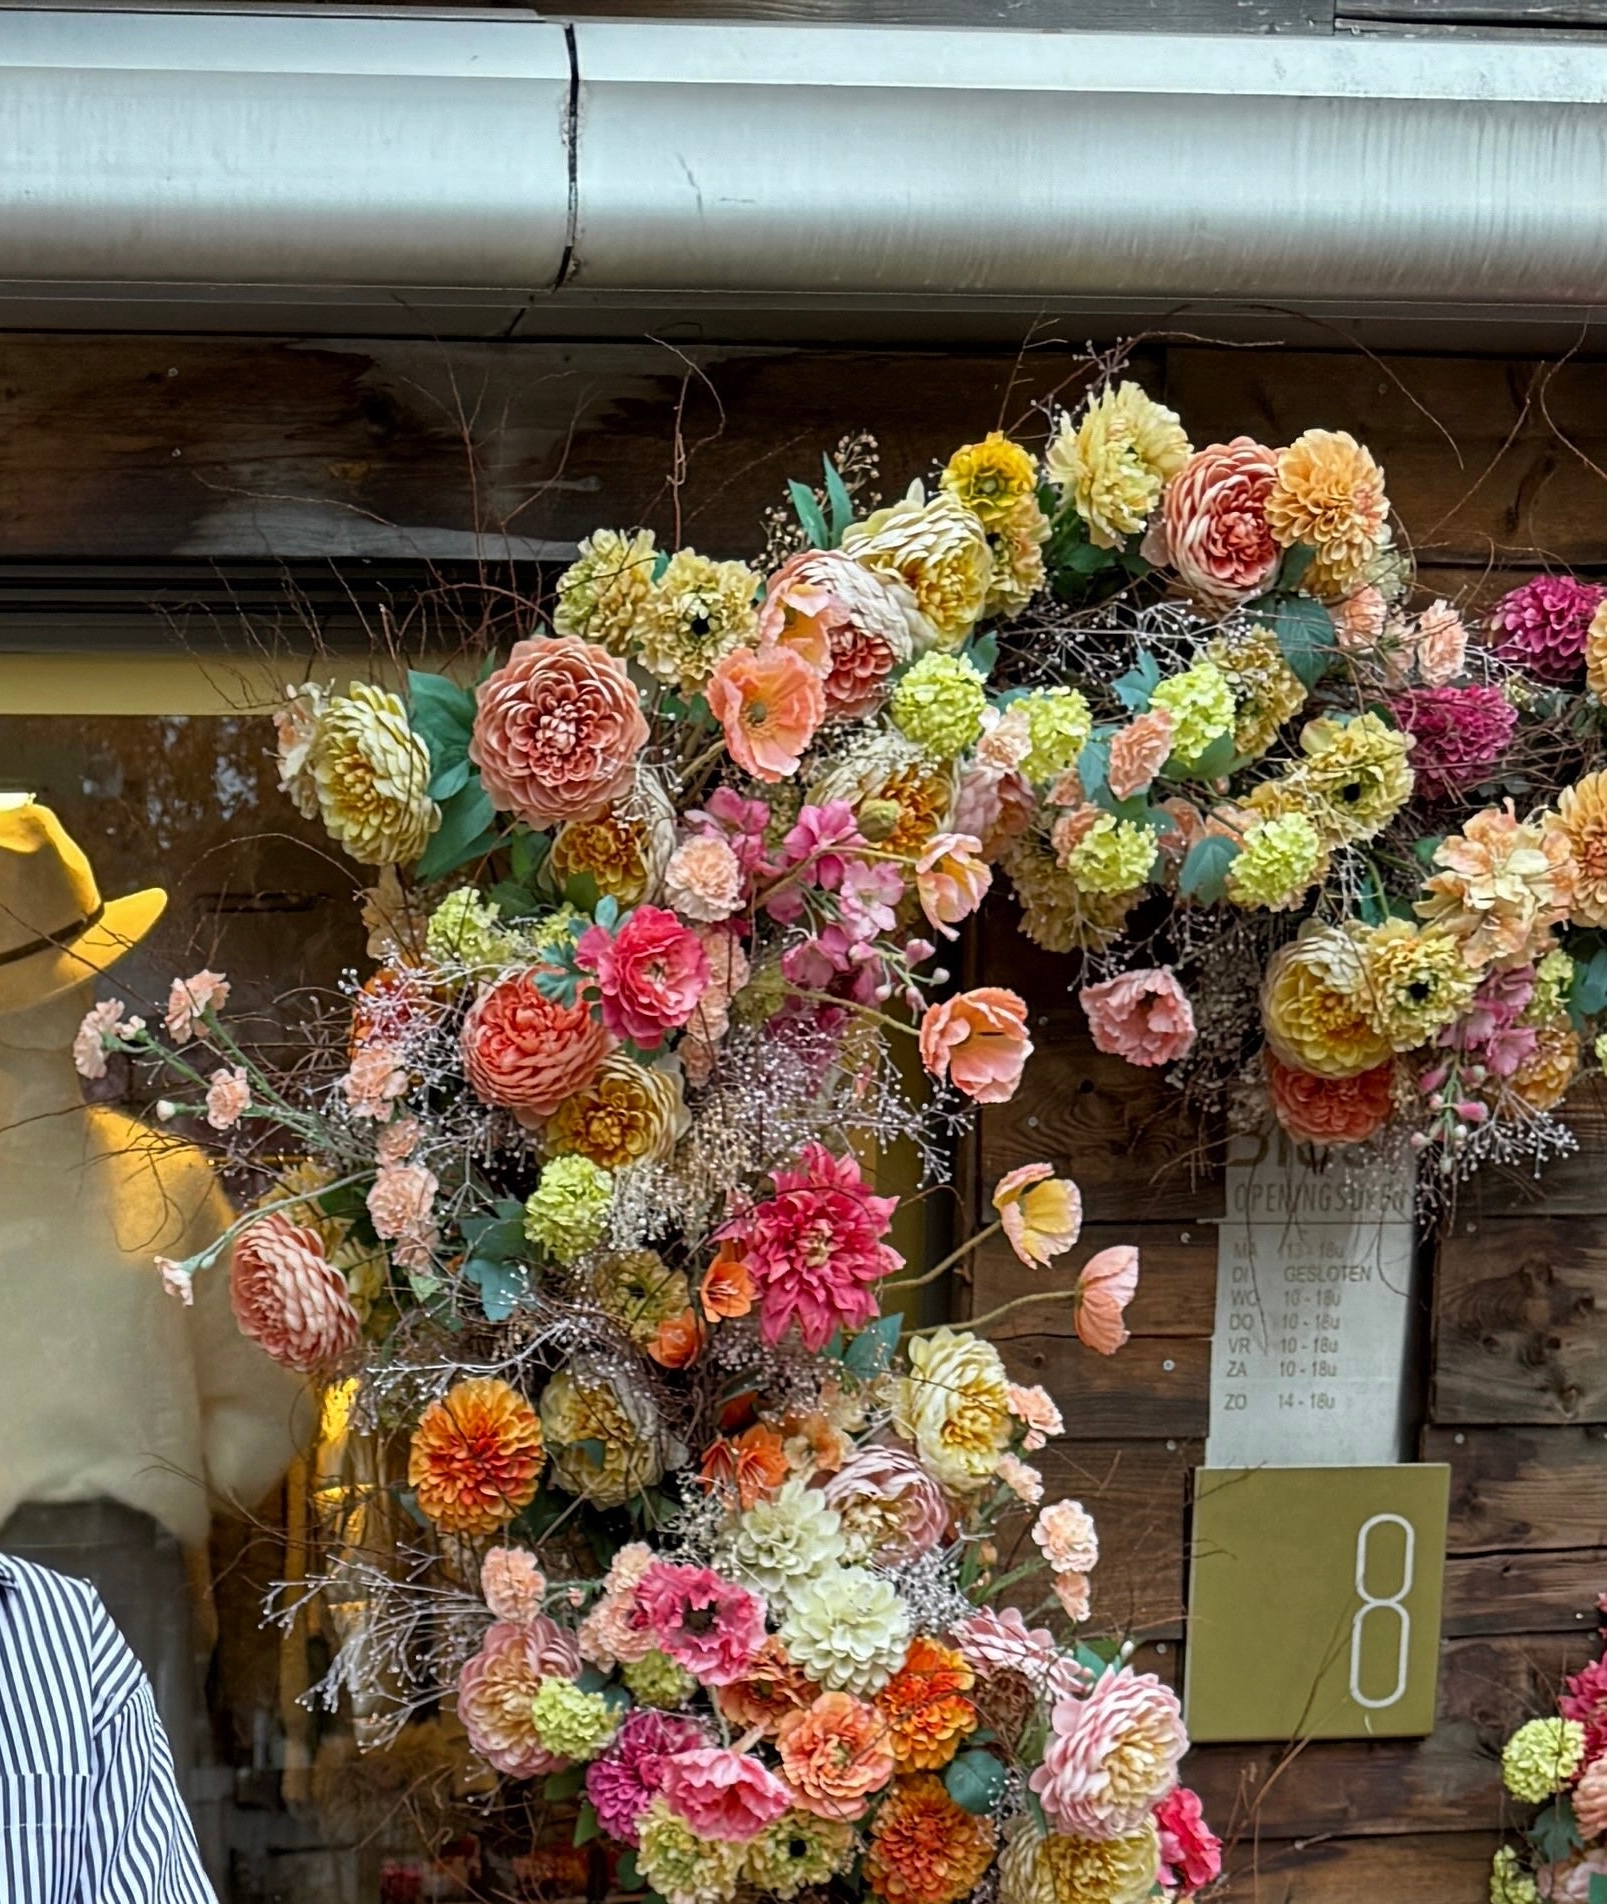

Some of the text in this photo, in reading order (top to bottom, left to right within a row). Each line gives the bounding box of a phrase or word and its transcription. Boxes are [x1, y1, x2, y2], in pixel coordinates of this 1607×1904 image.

[1232, 1264, 1372, 1283] DI GESLOTEN
[1229, 1313, 1254, 1330] DO
[1283, 1313, 1298, 1330] 10
[1228, 1337, 1251, 1354] VR
[1281, 1337, 1297, 1353] 10
[1313, 1337, 1339, 1353] 18u
[1226, 1361, 1247, 1377] ZA
[1280, 1361, 1296, 1377] 10
[1312, 1361, 1337, 1377] 18u
[1224, 1393, 1247, 1410] ZO
[1278, 1393, 1294, 1409] 14
[1310, 1393, 1335, 1410] 18u
[1350, 1513, 1415, 1708] 8
